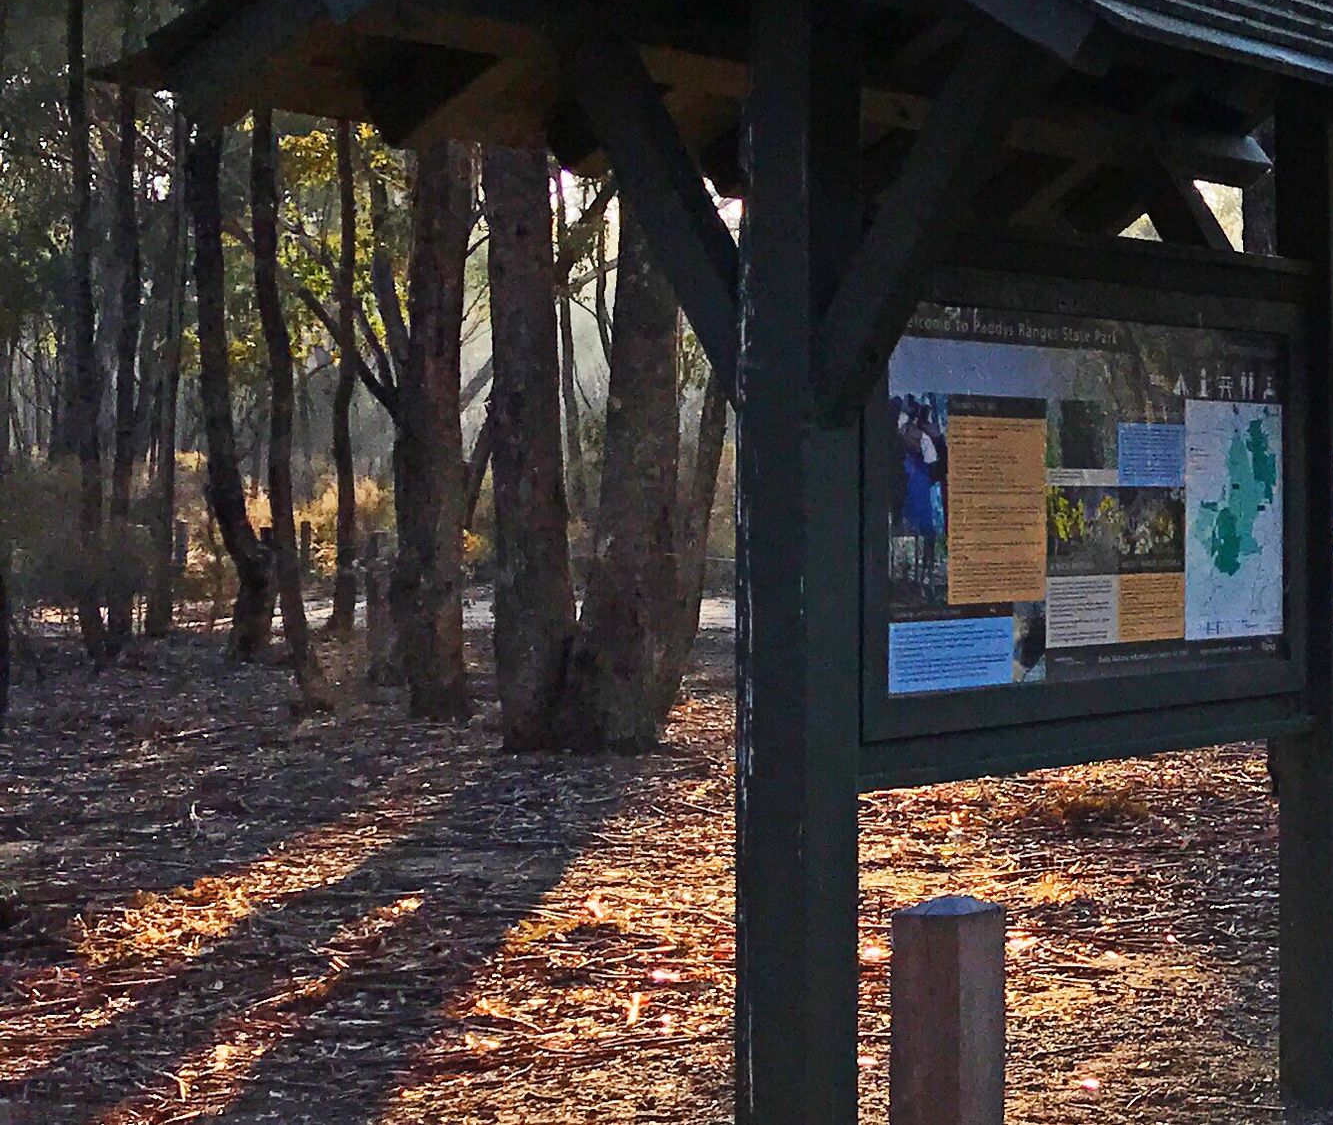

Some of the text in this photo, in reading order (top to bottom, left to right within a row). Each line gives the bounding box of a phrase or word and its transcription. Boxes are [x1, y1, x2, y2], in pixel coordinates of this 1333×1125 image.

[906, 315, 951, 331] elcome
[955, 320, 968, 332] to
[973, 318, 1014, 337] Paddys
[1062, 327, 1090, 343] State
[1093, 331, 1119, 345] Park
